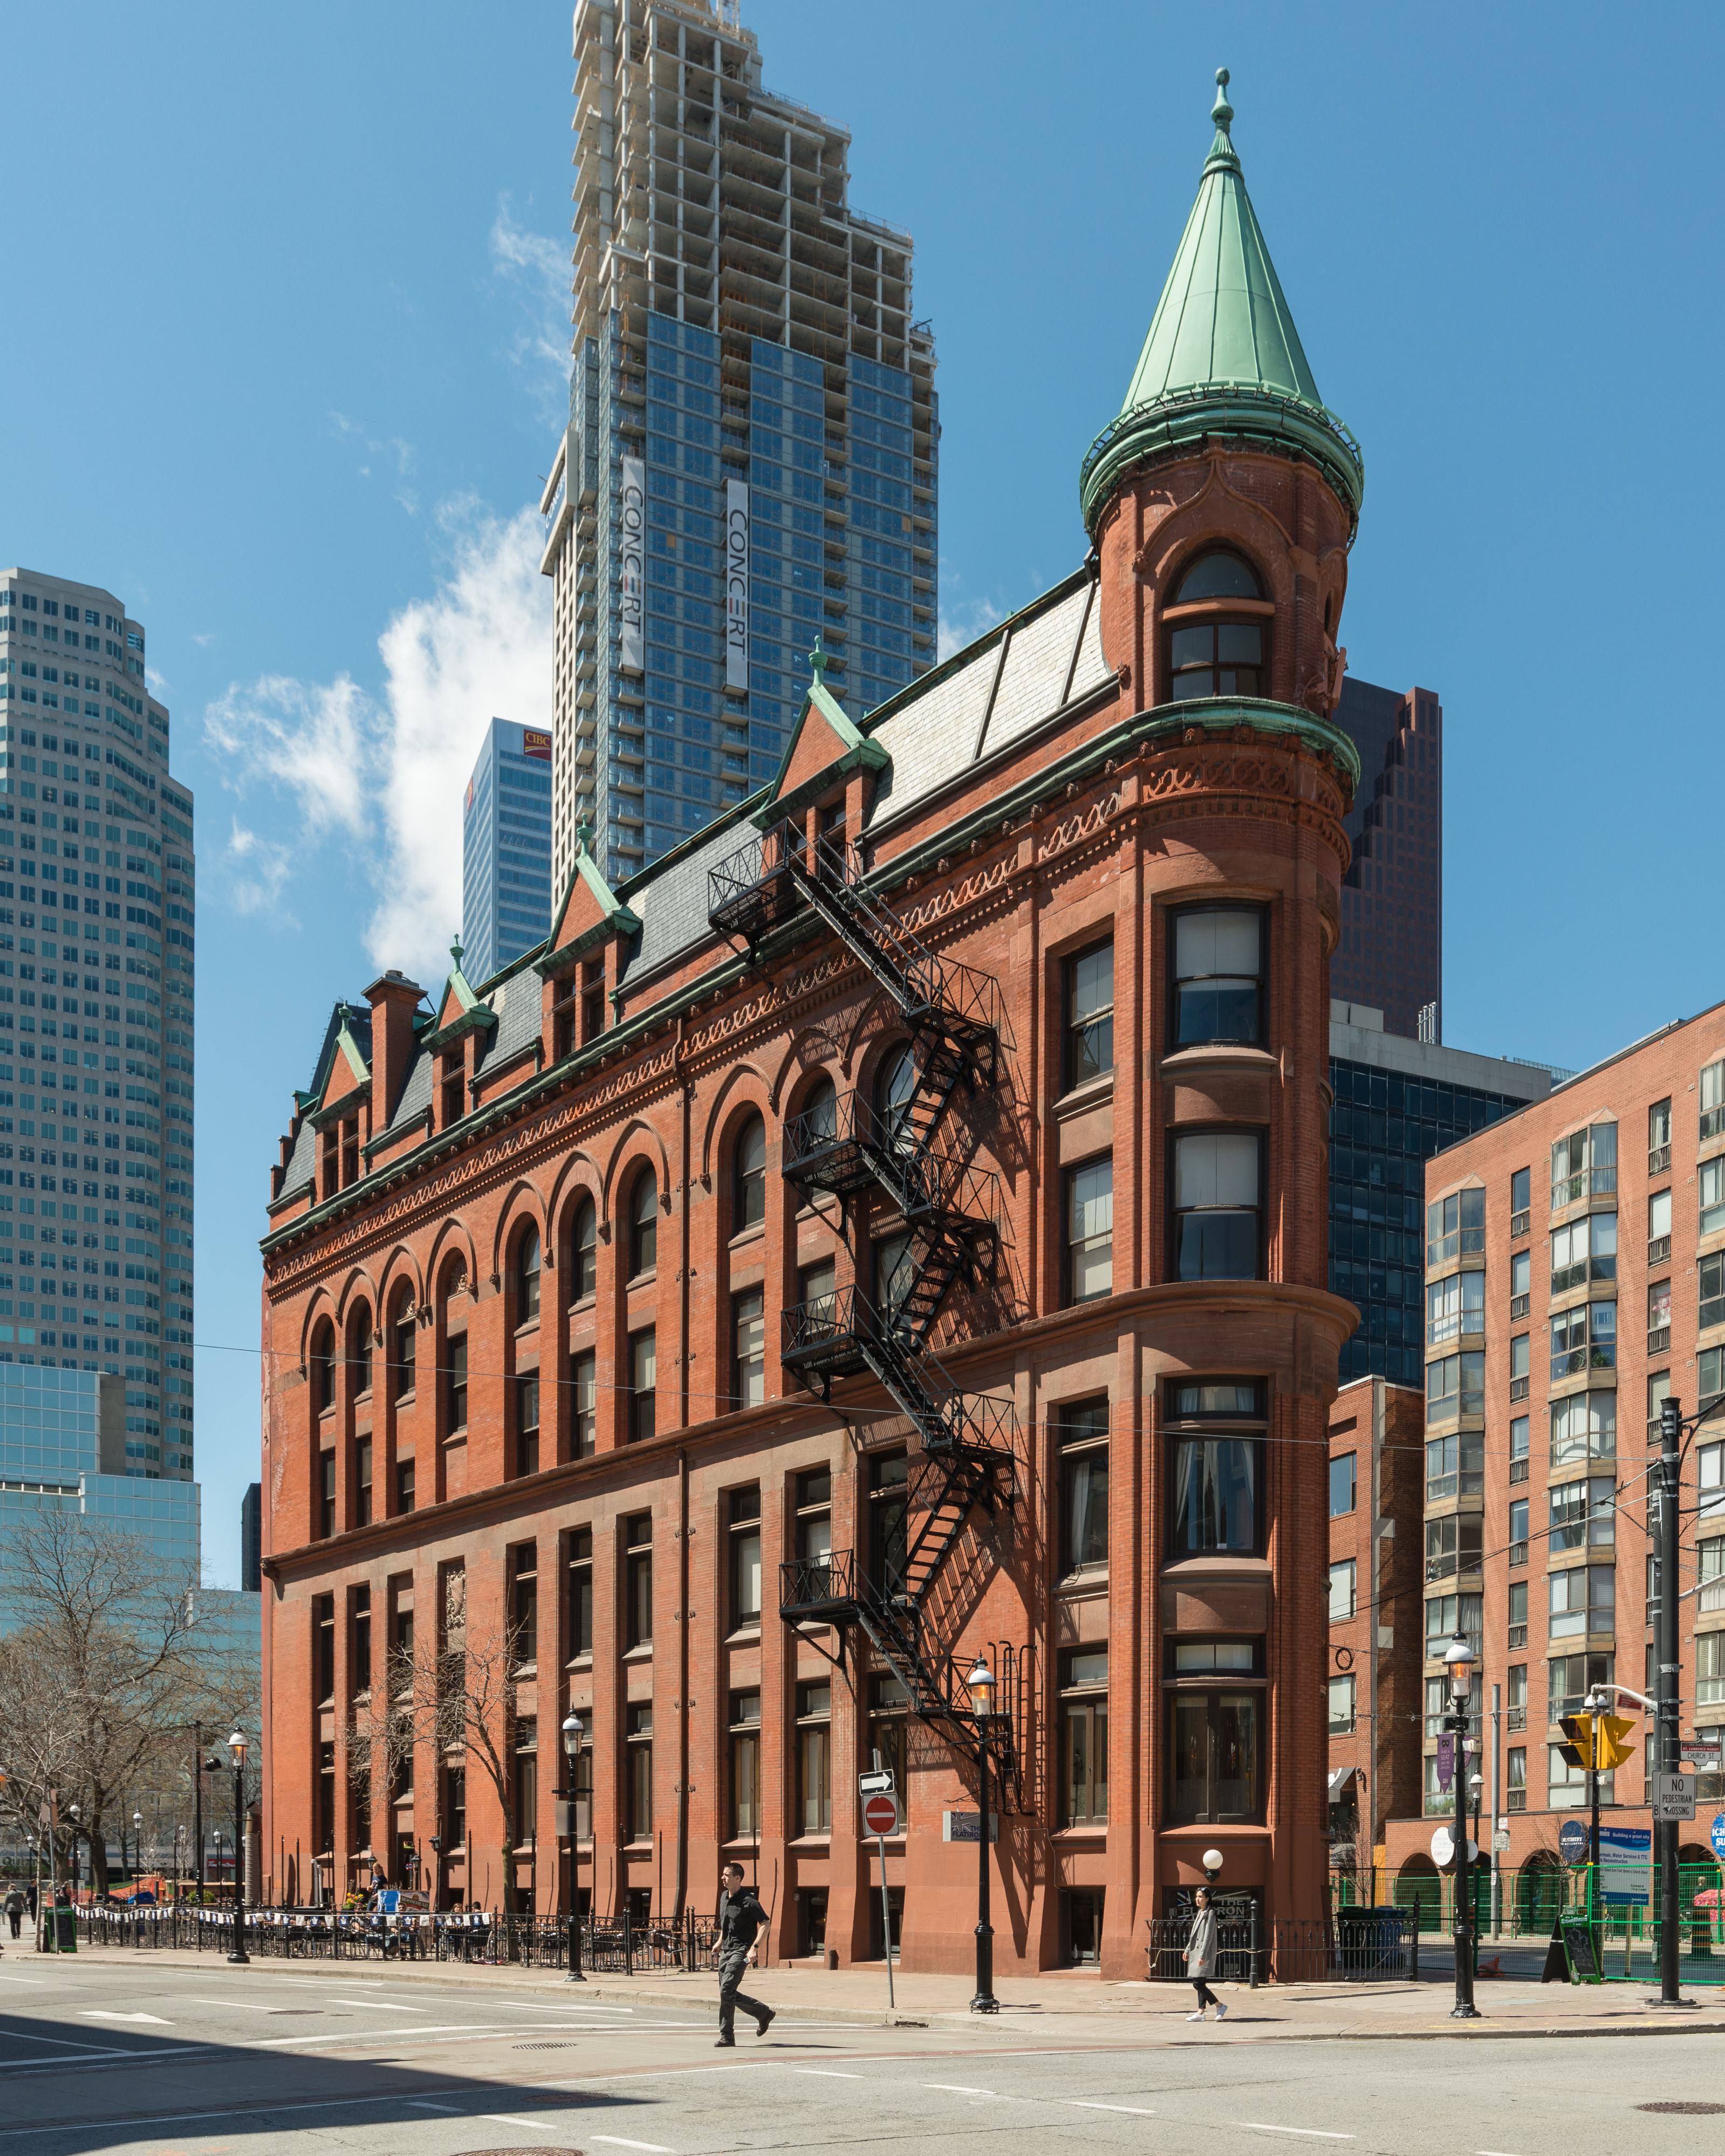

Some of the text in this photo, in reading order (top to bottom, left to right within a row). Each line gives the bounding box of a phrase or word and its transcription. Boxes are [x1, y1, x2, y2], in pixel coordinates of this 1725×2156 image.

[624, 485, 644, 634] CONCERT
[729, 508, 748, 656] CONCERT
[526, 733, 550, 747] CIBC
[1672, 1778, 1684, 1791] NO
[1662, 1794, 1692, 1803] PEDESTRIAN
[401, 1897, 428, 1907] MOOSEHEAD
[1182, 1906, 1245, 1915] FLRON
